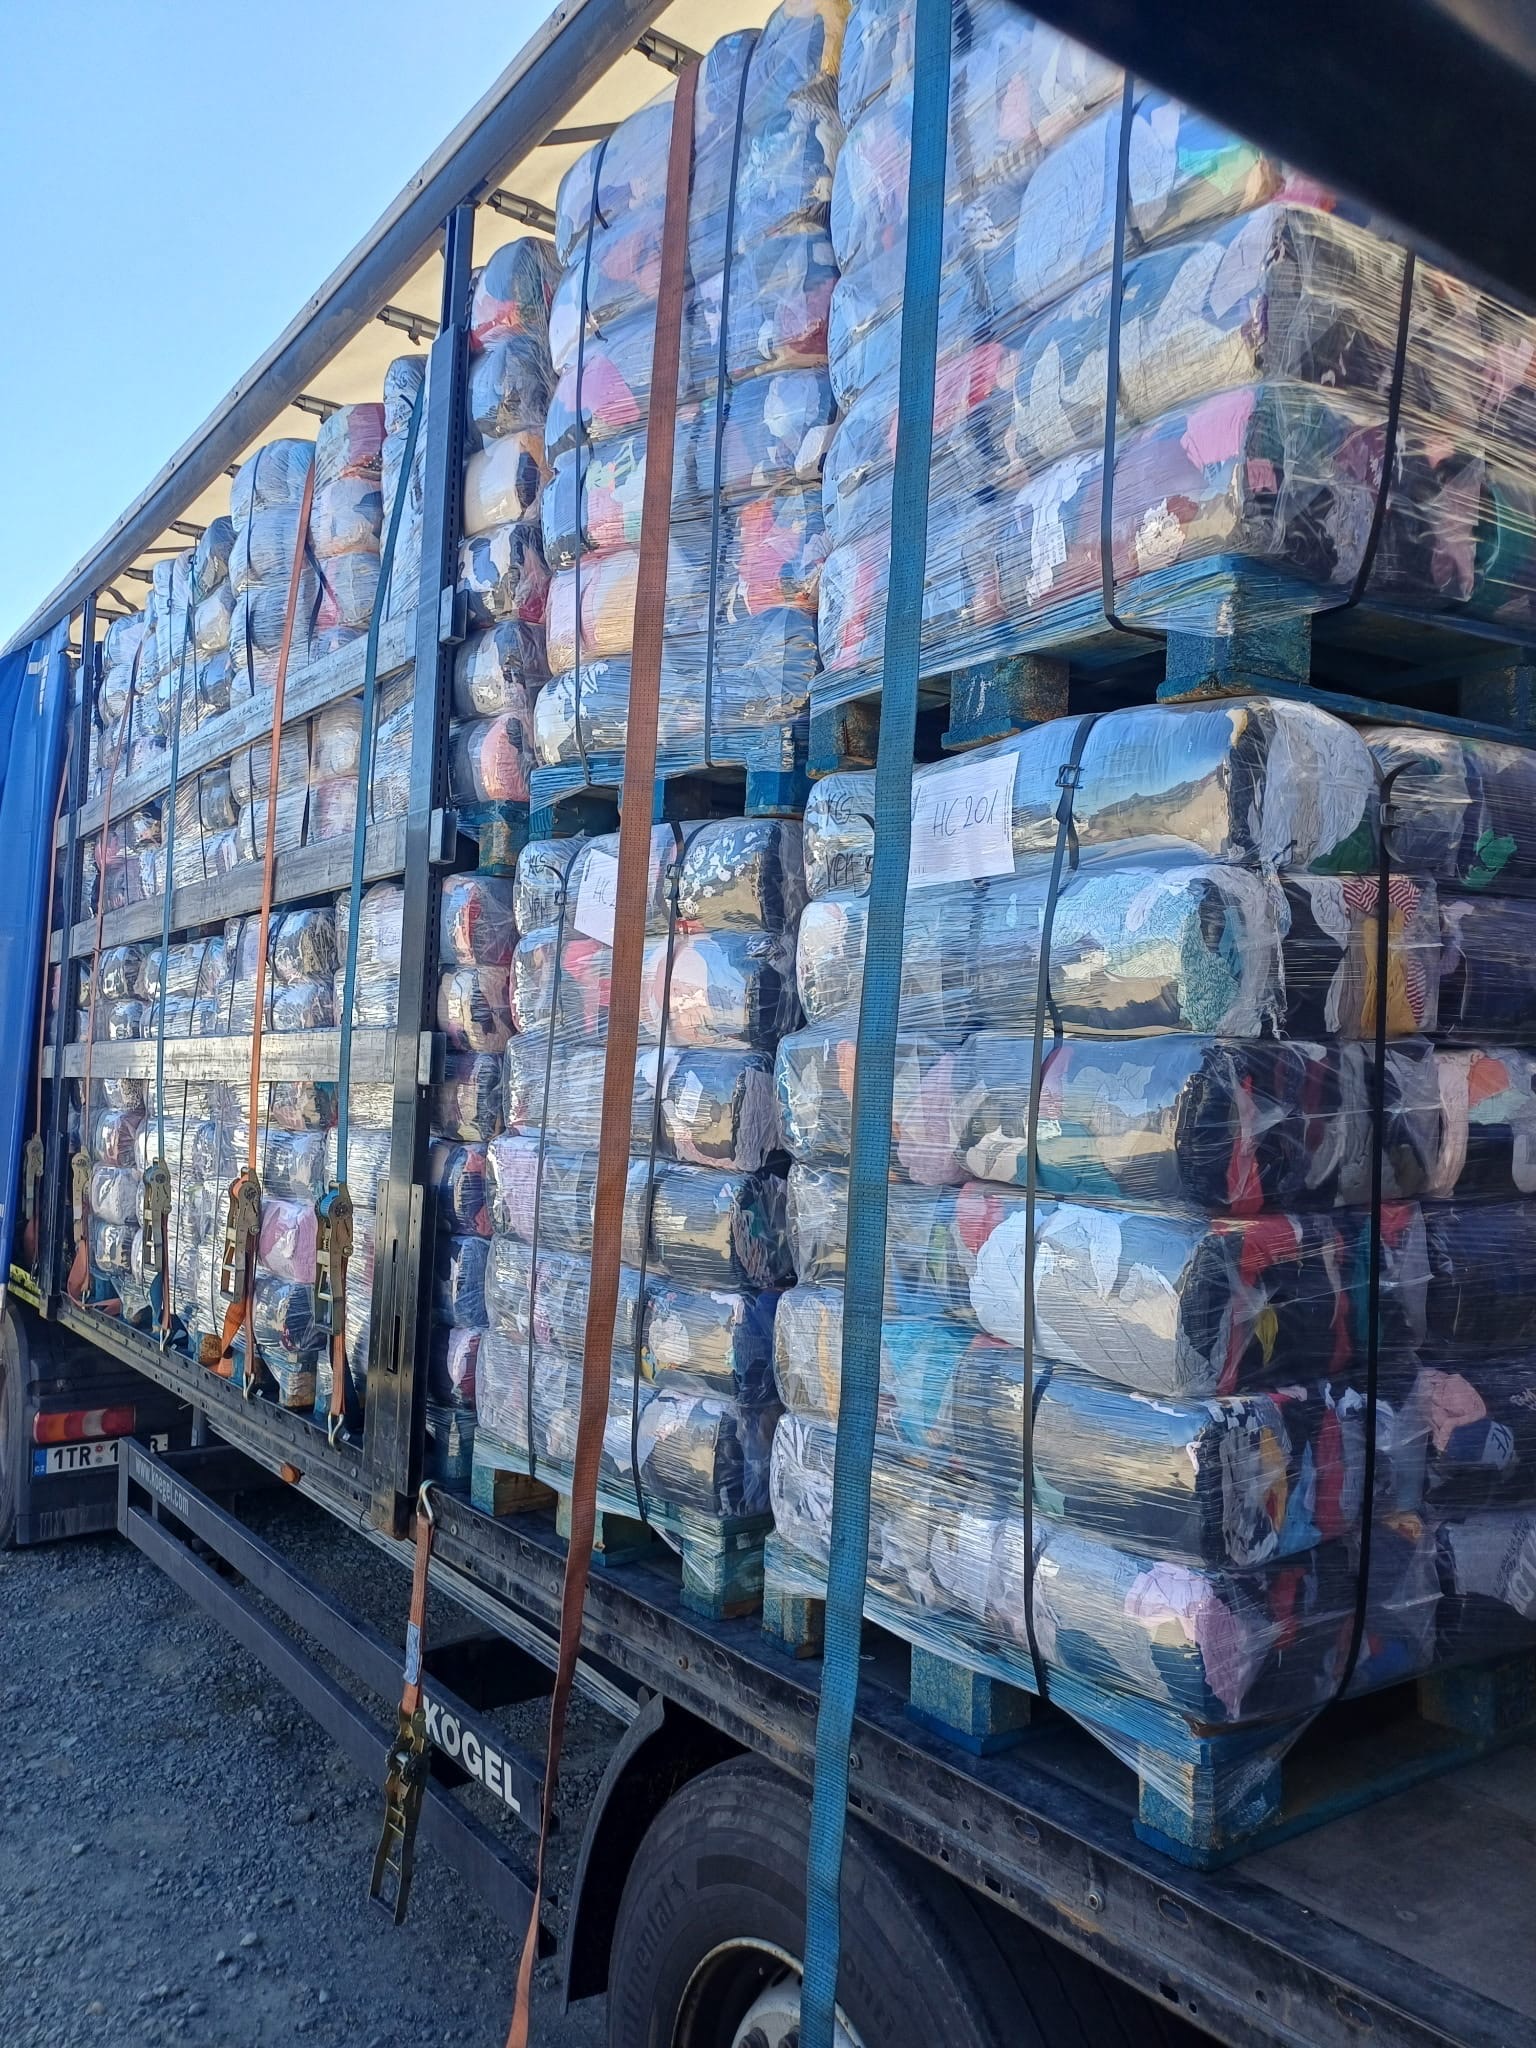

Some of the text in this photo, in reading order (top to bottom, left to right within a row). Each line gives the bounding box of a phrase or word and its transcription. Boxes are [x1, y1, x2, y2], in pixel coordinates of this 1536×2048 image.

[53, 1445, 92, 1470] 1TR
[135, 1455, 190, 1517] www.koegel.com
[422, 1694, 521, 1814] KÖGEL
